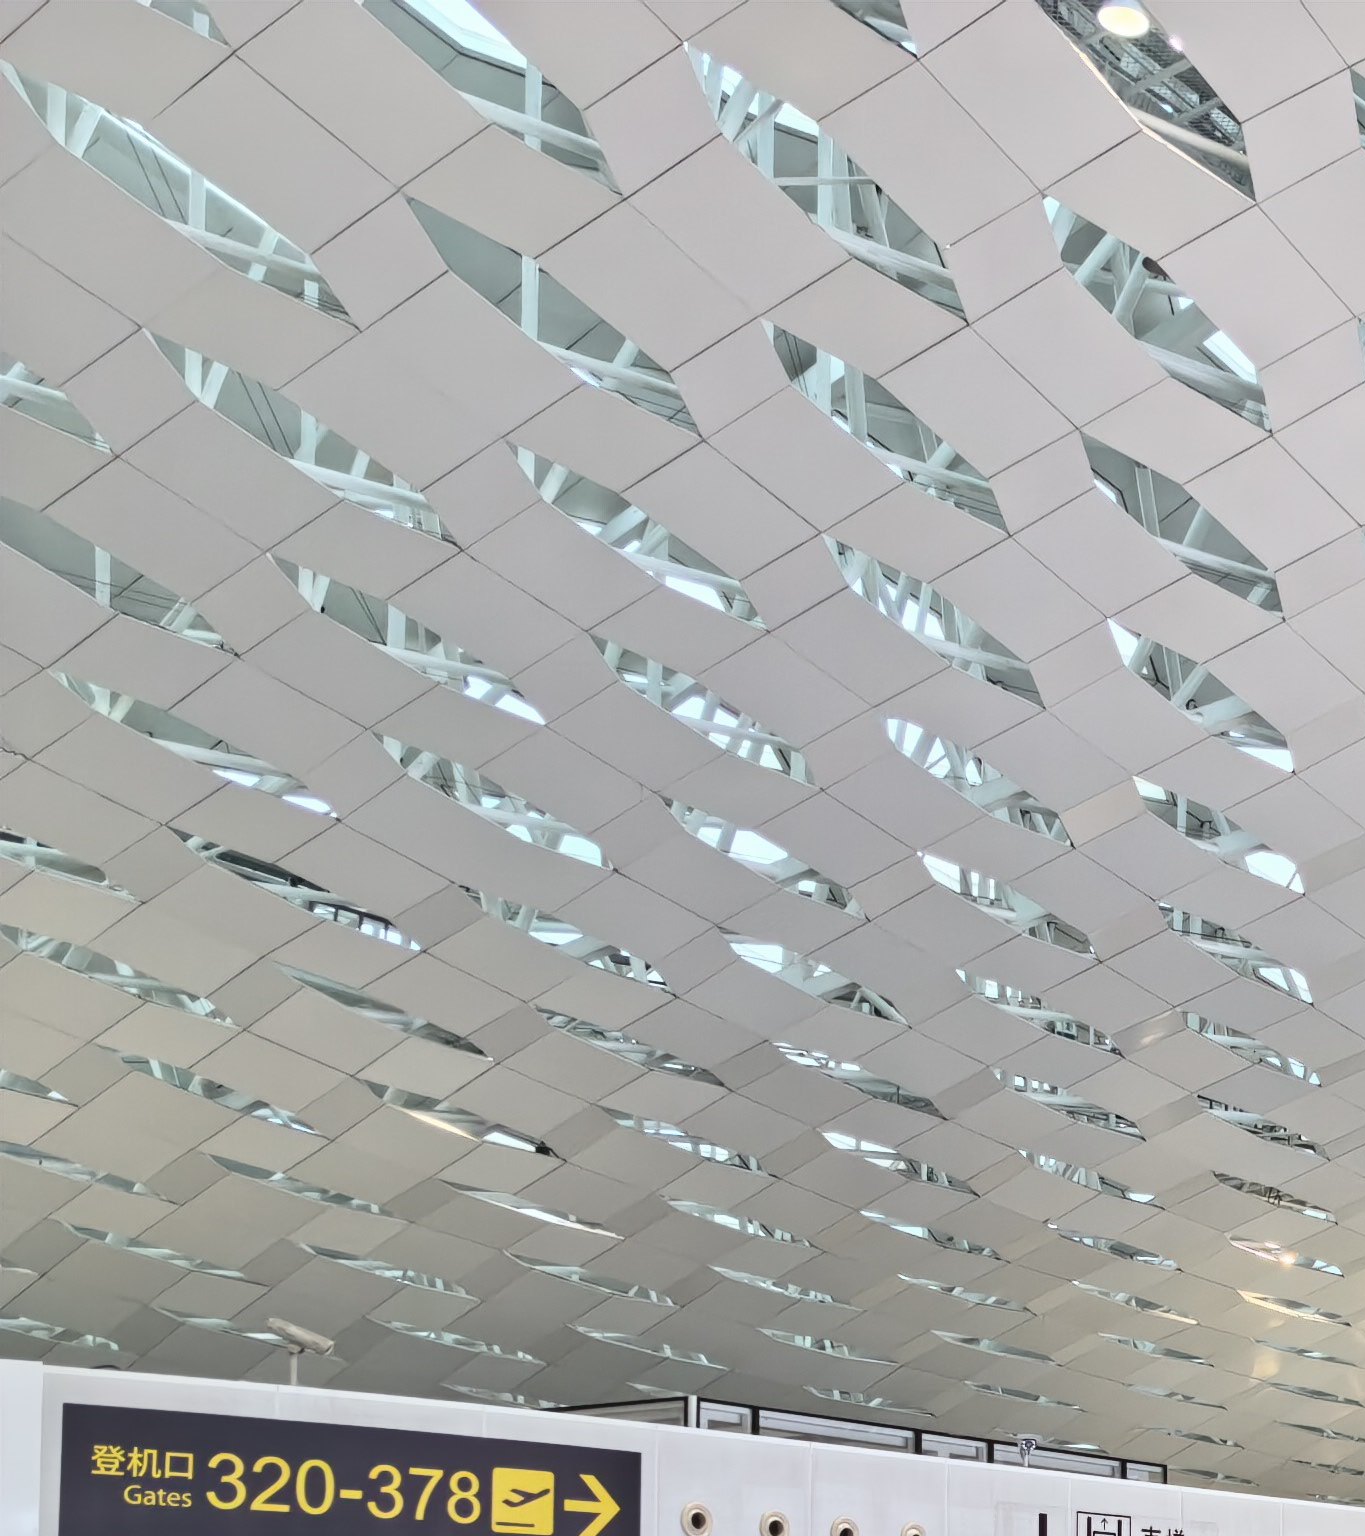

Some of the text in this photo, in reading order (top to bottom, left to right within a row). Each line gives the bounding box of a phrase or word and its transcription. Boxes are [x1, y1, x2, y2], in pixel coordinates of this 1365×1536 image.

[91, 1445, 194, 1480] 登机口
[123, 1485, 193, 1508] Gates
[206, 1452, 481, 1524] 320-378
